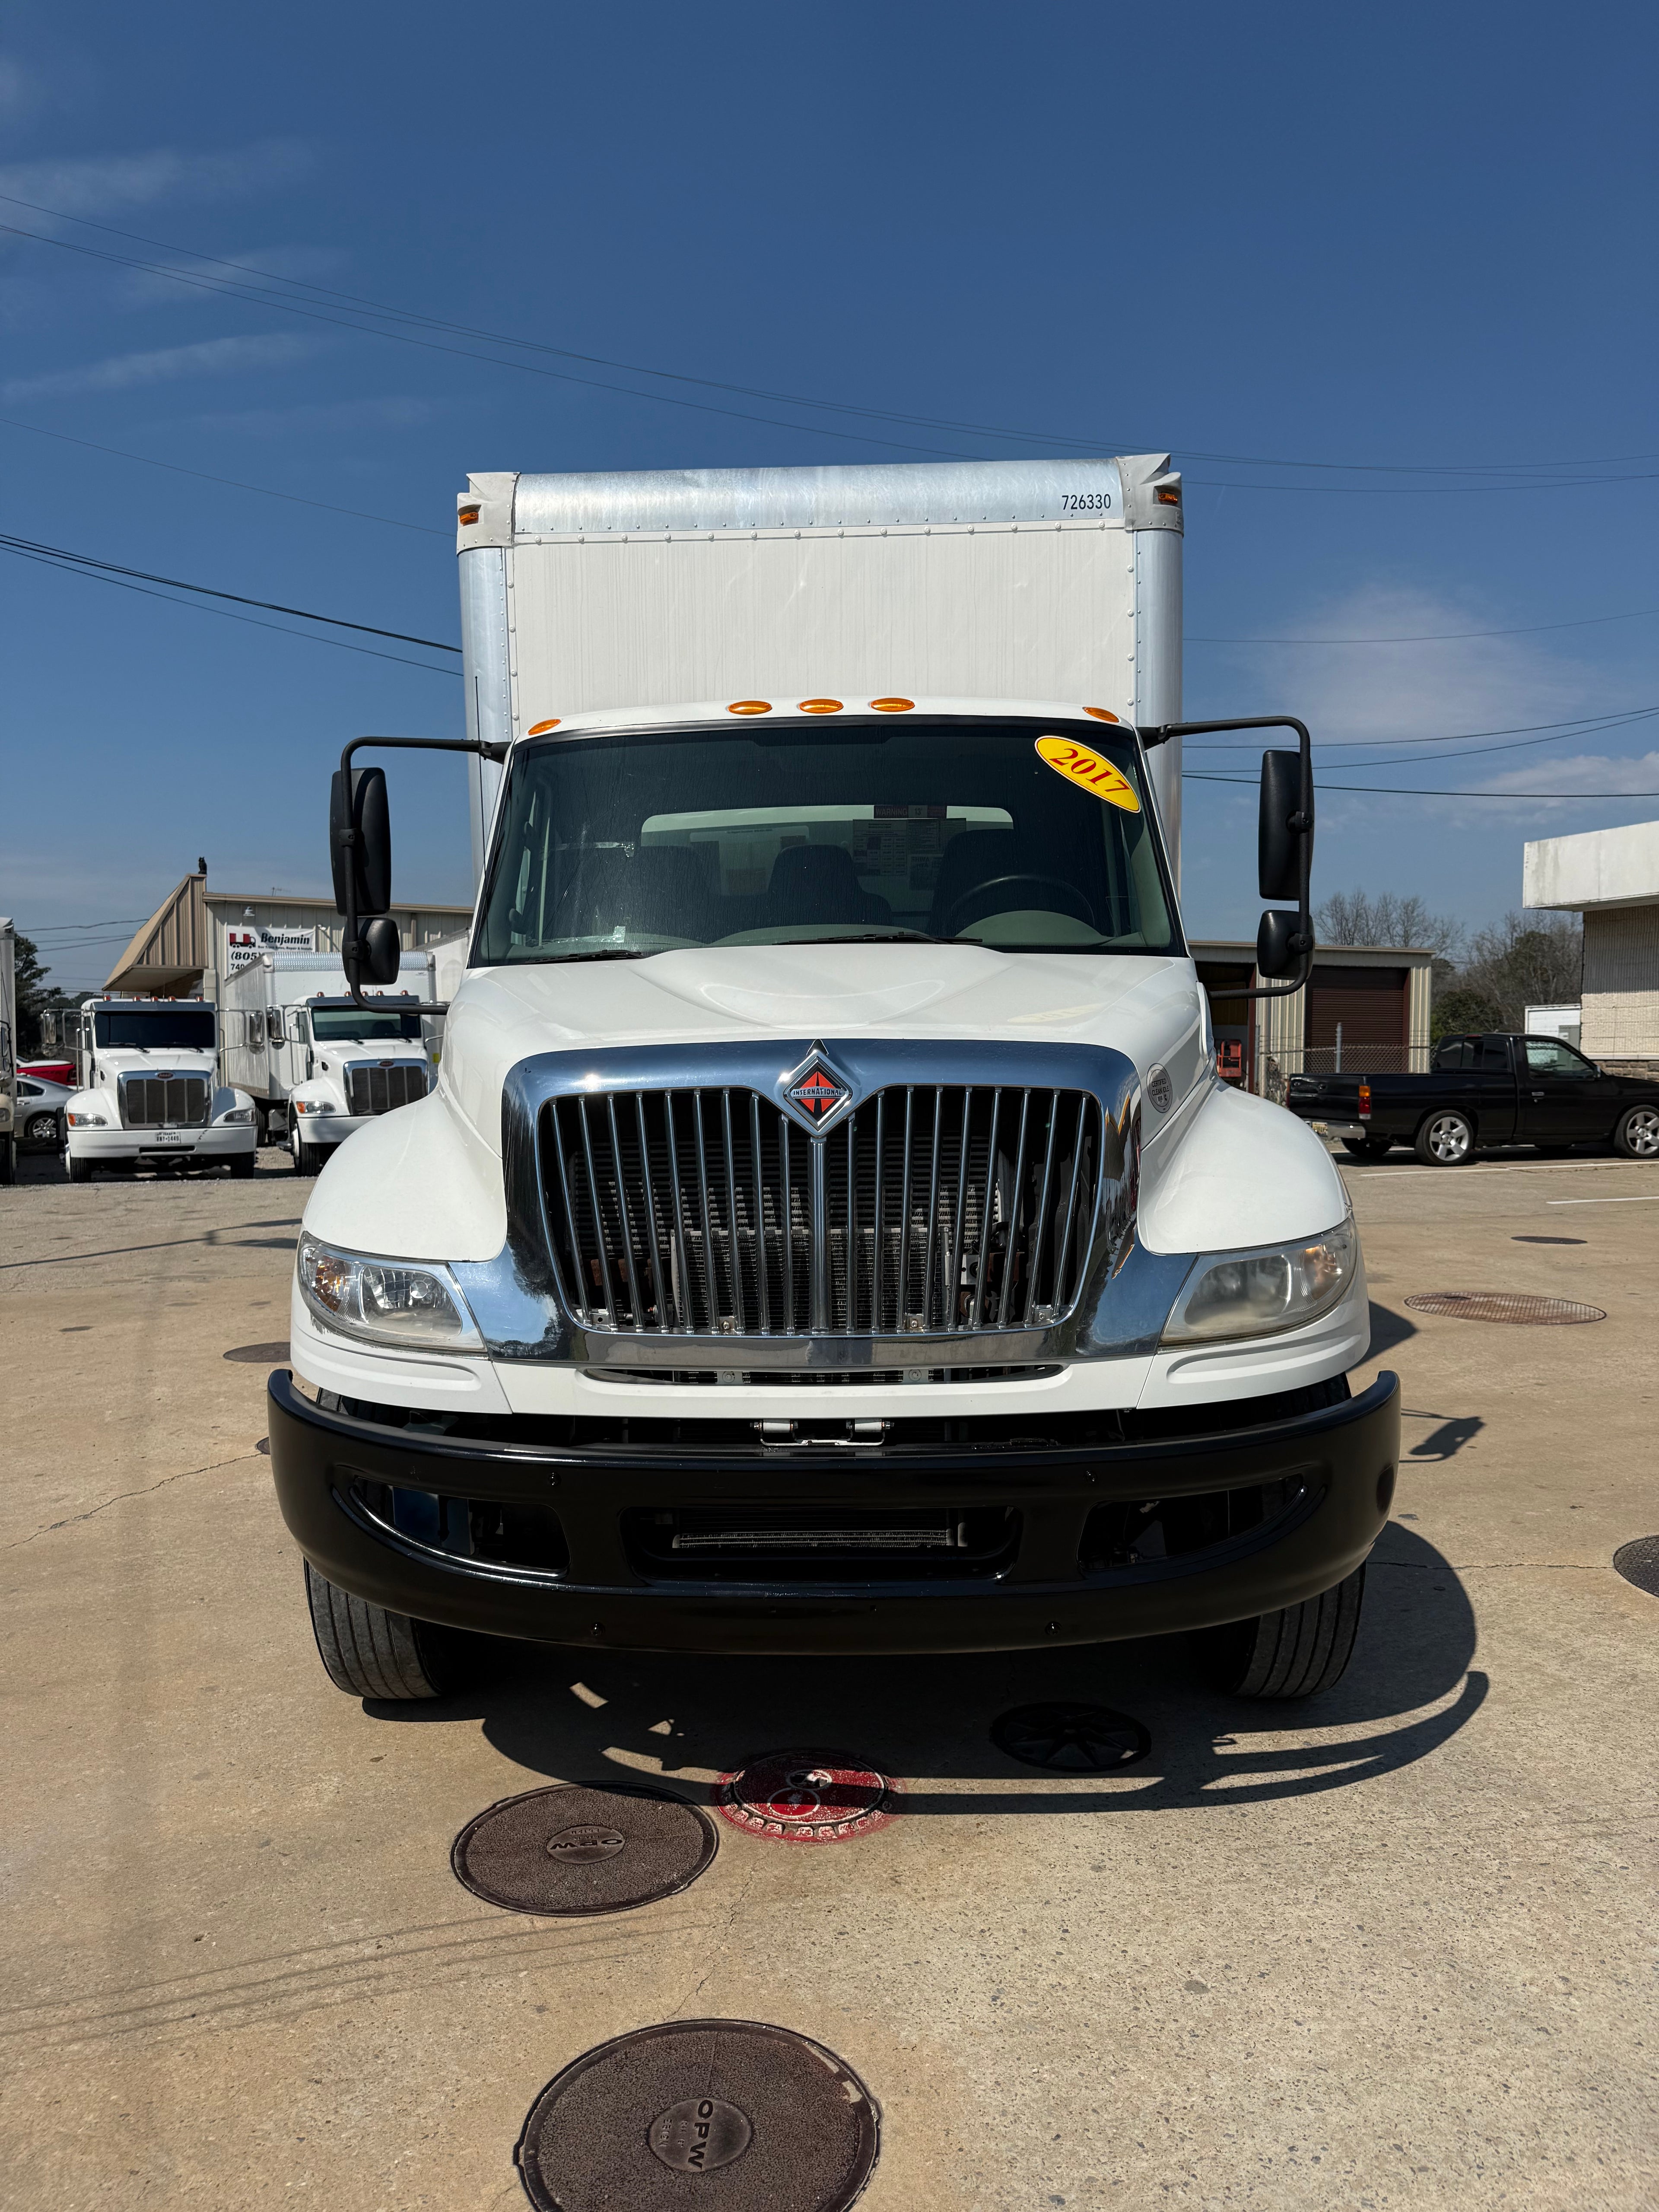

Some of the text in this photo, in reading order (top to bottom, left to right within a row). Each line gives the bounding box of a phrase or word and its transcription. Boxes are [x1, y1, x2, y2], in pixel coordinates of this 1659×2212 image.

[1062, 494, 1111, 510] 726330
[1049, 748, 1130, 792] 2017
[876, 808, 907, 816] WARNING
[261, 933, 309, 945] Benjamin
[793, 1088, 842, 1096] INTERNATIONAL
[550, 1839, 623, 1850] OPW
[688, 2100, 713, 2170] OPW
